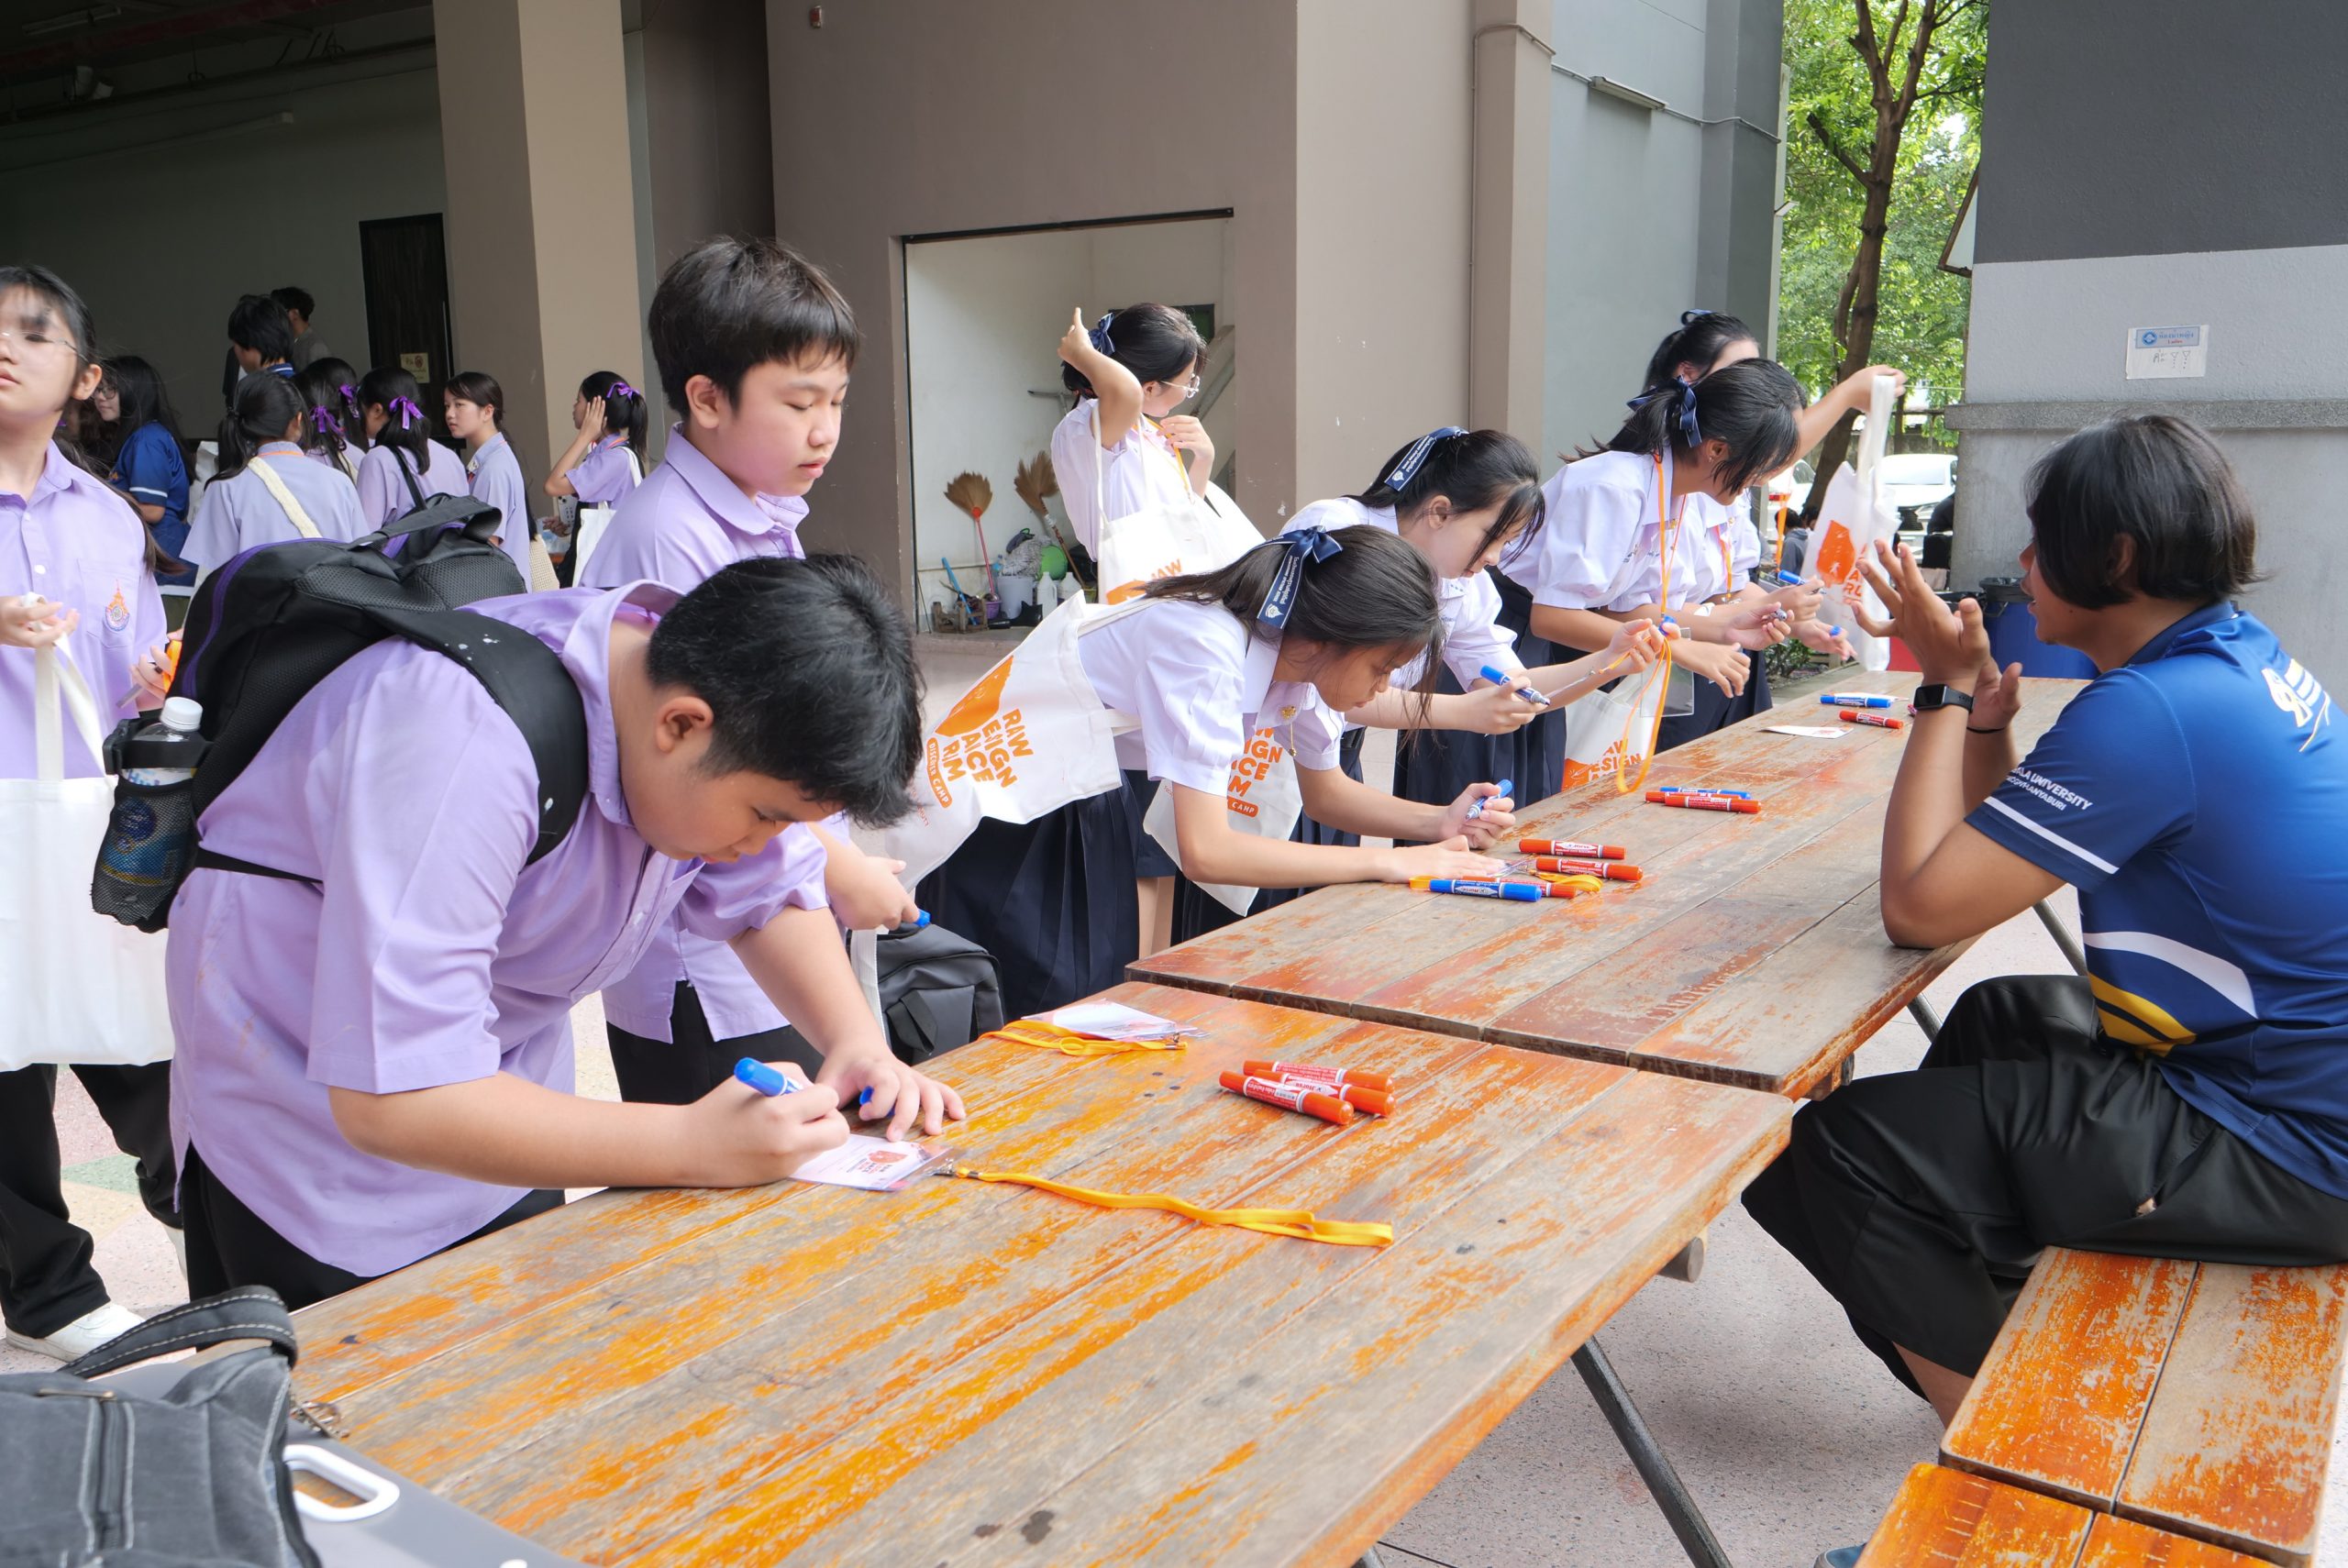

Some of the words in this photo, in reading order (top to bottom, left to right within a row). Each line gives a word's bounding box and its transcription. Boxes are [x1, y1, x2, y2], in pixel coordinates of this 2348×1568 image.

[1002, 708, 1035, 757] RAW
[1244, 737, 1283, 764] IGN
[932, 778, 950, 803] CAMP
[2031, 773, 2093, 811] UNIVERSITY
[1232, 801, 1256, 814] CAMP
